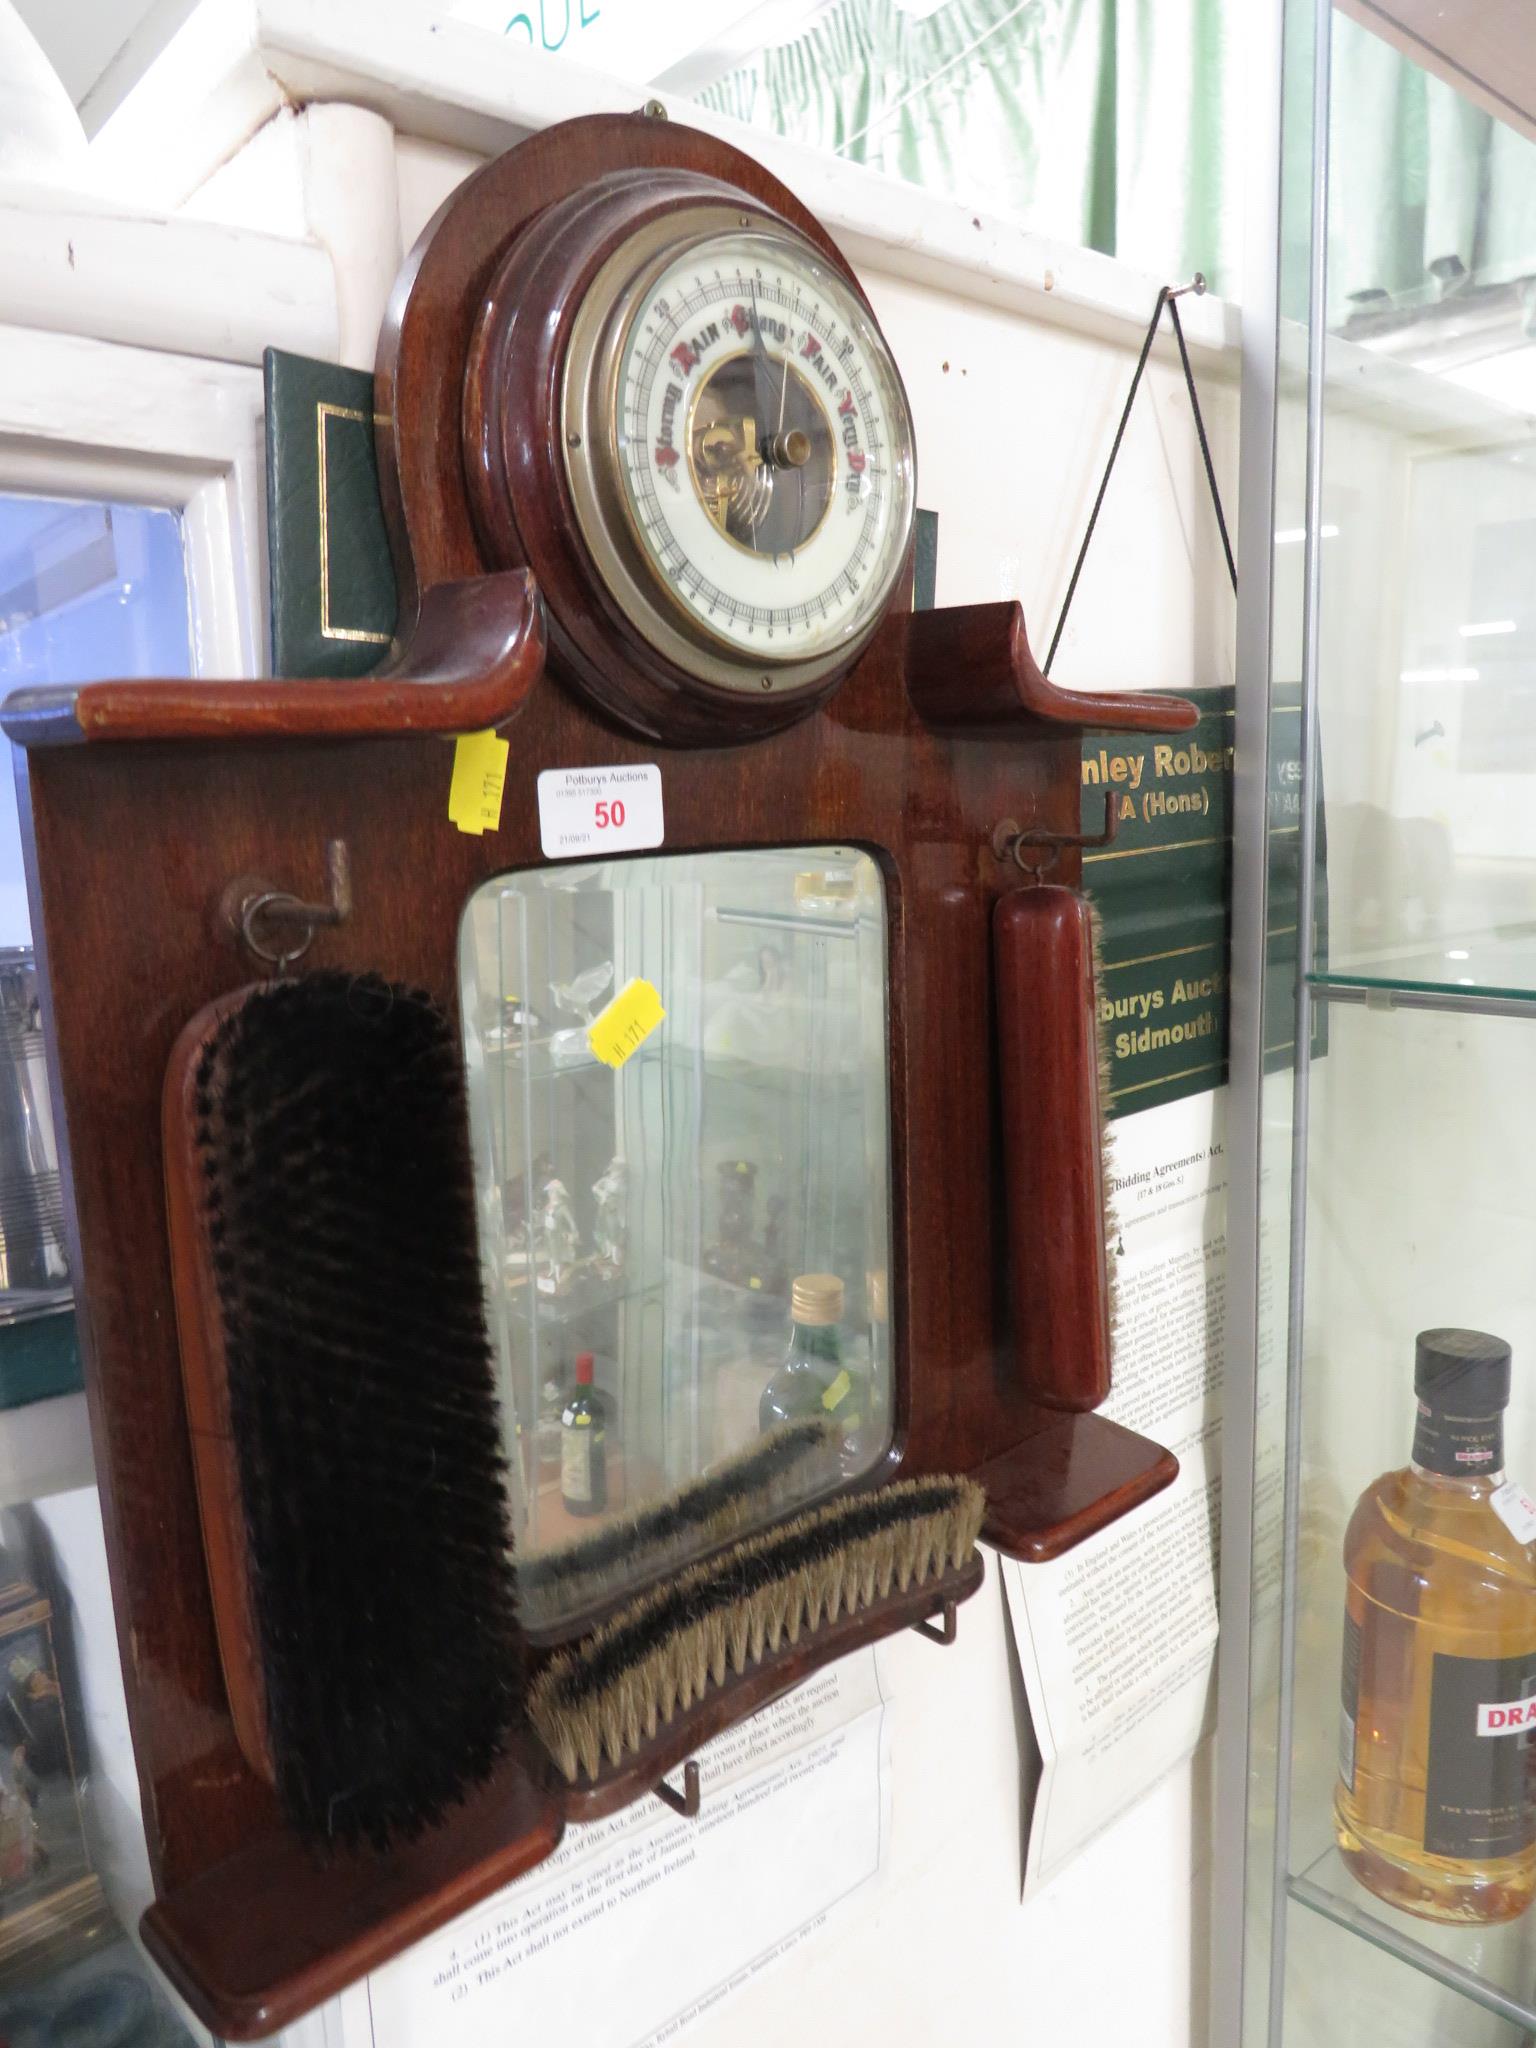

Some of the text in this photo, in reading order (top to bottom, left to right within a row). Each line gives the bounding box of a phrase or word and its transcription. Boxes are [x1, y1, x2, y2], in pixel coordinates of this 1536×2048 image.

[800, 332, 838, 391] FAIR
[565, 771, 649, 787] Potburys Auctions
[595, 800, 626, 829] 50
[1143, 786, 1210, 824] (Hons)
[1115, 1010, 1218, 1059] Sidmouth
[1153, 1150, 1206, 1178] Agreements)
[477, 1964, 502, 1986] This
[503, 1950, 522, 1969] Act
[525, 1933, 551, 1957] shall
